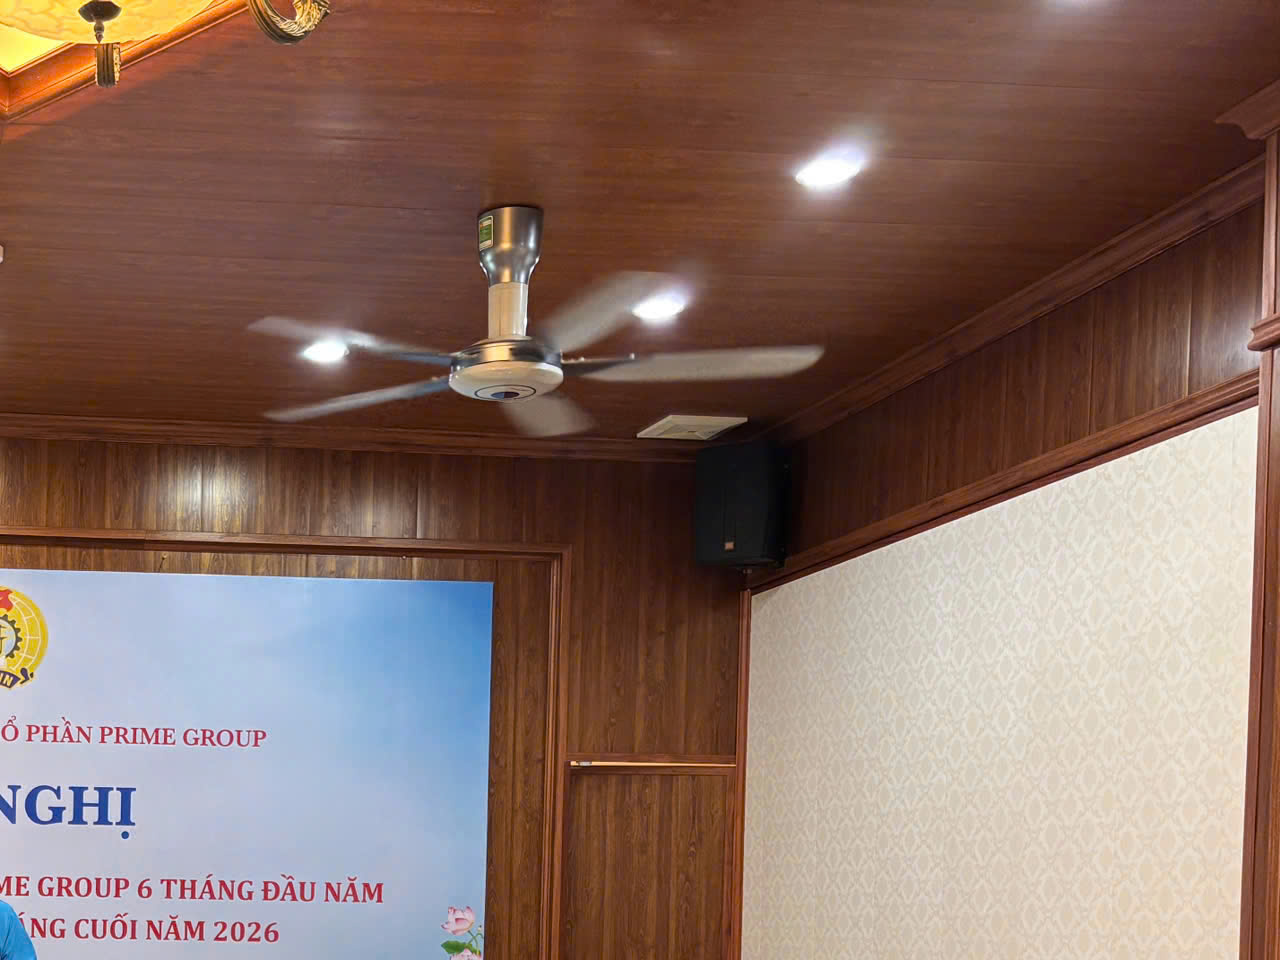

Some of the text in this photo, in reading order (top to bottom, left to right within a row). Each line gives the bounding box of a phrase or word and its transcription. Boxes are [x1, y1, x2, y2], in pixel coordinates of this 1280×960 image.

[26, 716, 92, 745] PHẦN
[100, 726, 176, 747] PRIME
[183, 728, 267, 749] GROUP
[37, 876, 130, 899] GROUP
[137, 879, 153, 899] 6
[160, 874, 254, 901] THÁNG
[262, 874, 317, 902] ĐẦU
[323, 876, 385, 904] NĂM
[73, 912, 137, 940] CUỐI
[146, 914, 206, 942] NĂM
[213, 920, 280, 943] 2026
